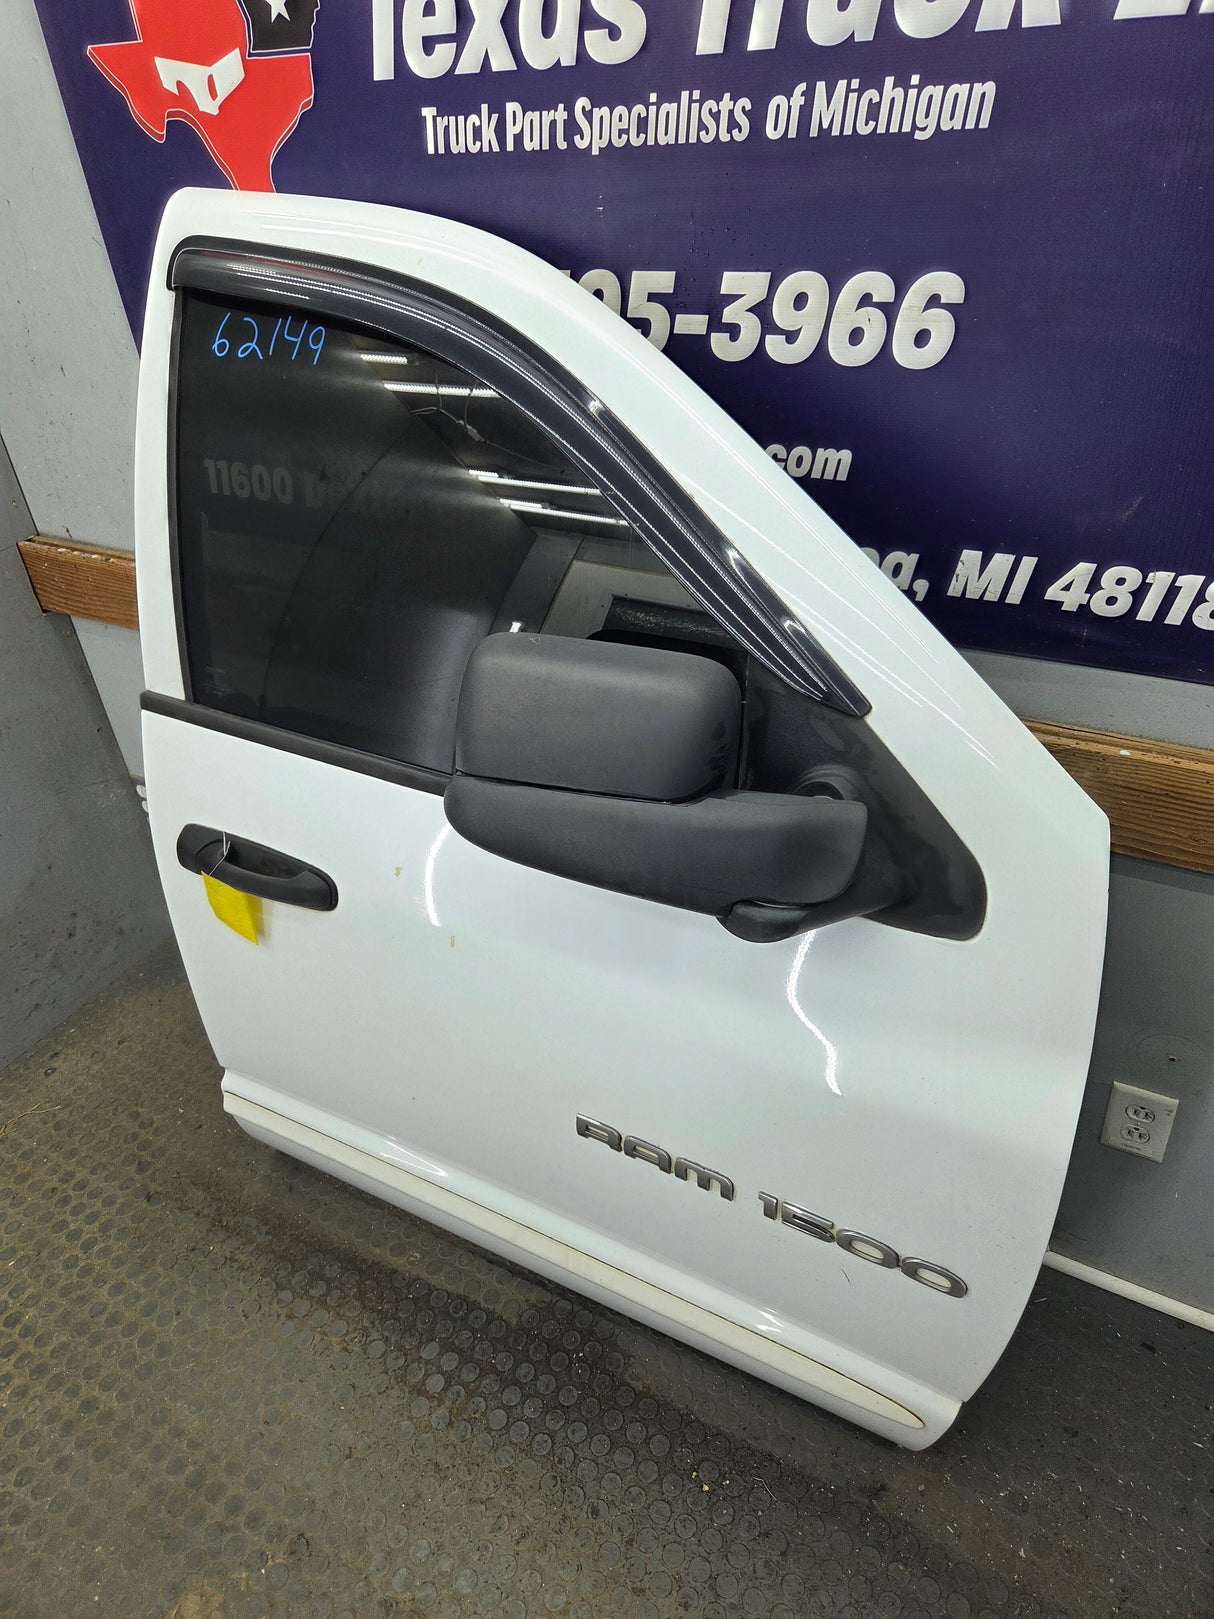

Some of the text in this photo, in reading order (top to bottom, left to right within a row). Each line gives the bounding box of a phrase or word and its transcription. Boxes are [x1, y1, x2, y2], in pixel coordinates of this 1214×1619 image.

[421, 74, 997, 156] Truck Part Specialists of Michigan
[211, 312, 326, 365] 62149
[558, 268, 966, 370] 5-3966
[203, 458, 293, 505] 11600
[946, 549, 1039, 605] MI
[757, 1190, 969, 1299] 1500
